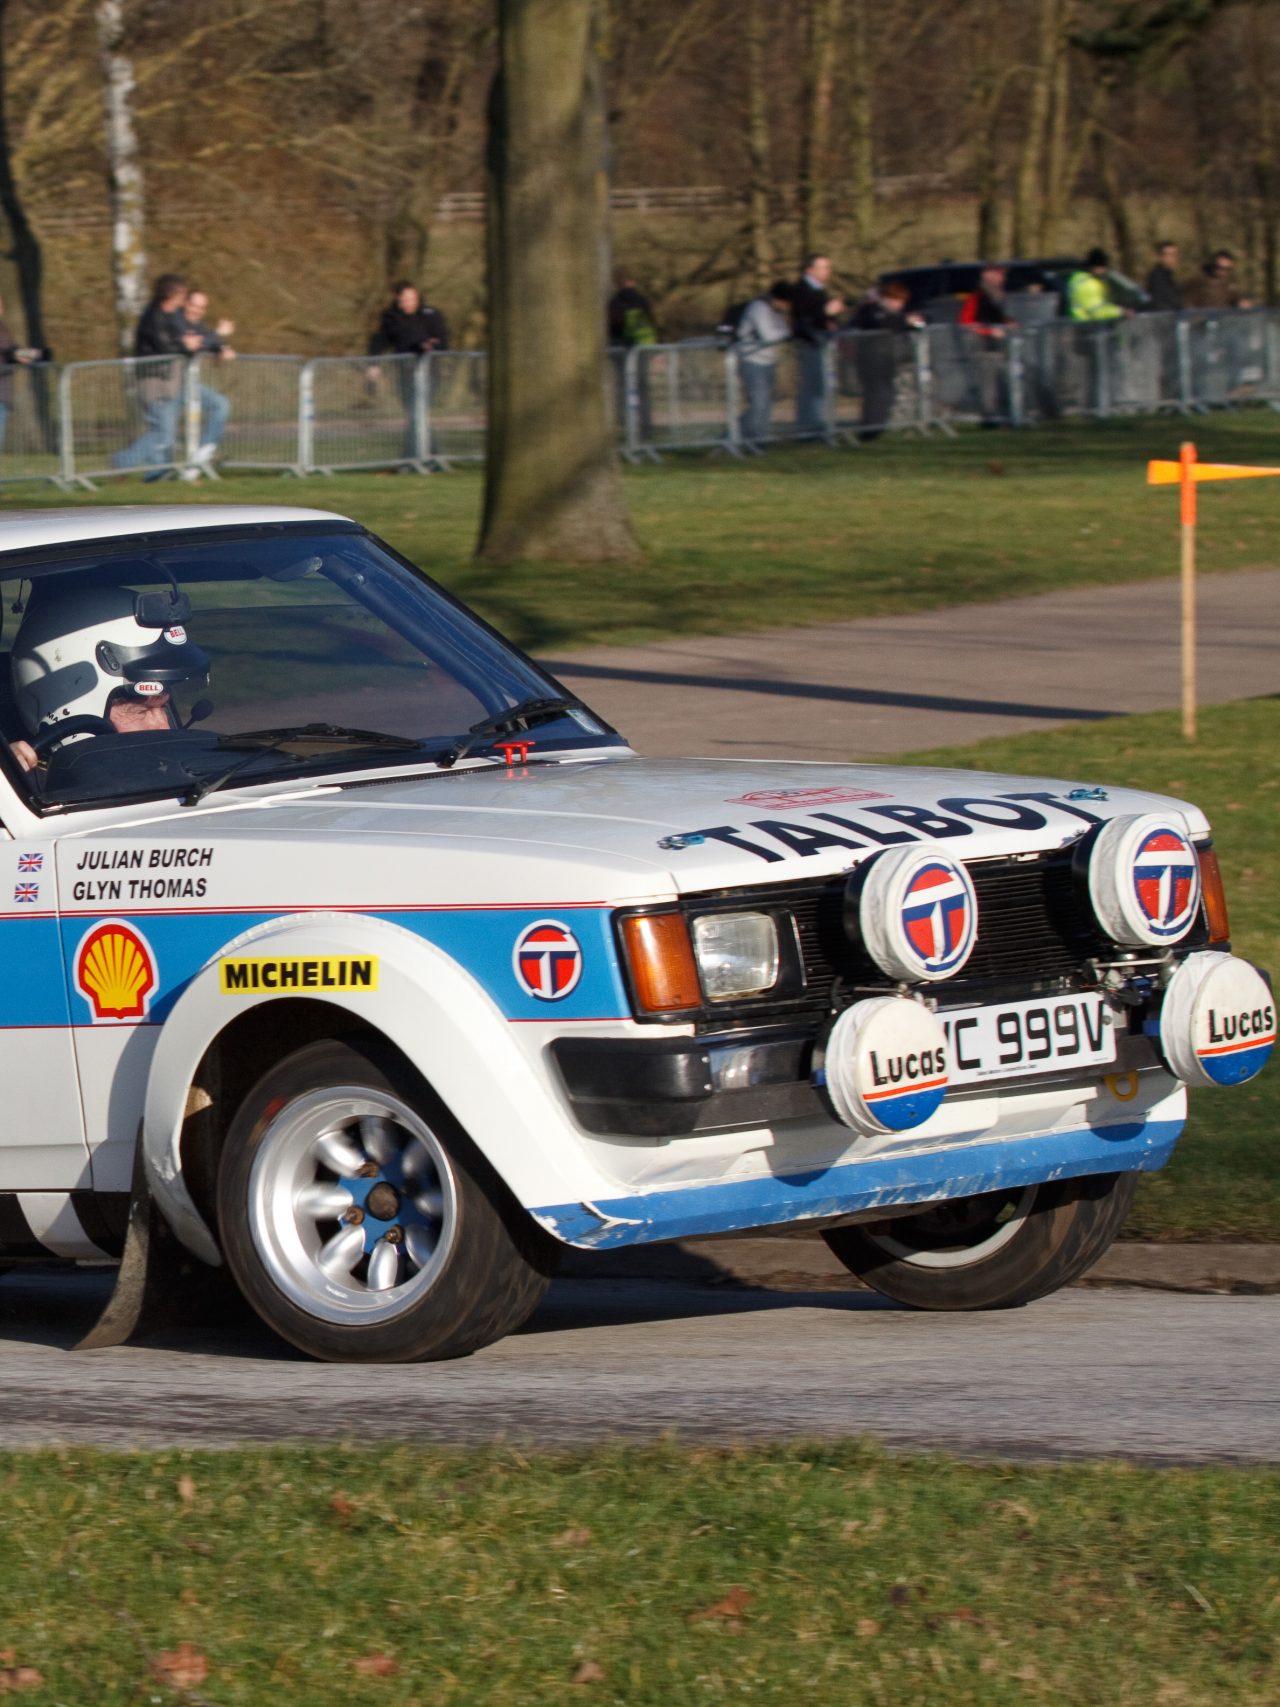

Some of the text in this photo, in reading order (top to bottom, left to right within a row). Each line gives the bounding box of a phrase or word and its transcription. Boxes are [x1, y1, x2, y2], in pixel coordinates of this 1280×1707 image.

[139, 684, 159, 692] BELL
[674, 792, 1103, 863] TALBOT
[77, 848, 214, 870] JULIAN BURCH
[73, 878, 207, 901] GLYN THOMAS
[225, 960, 372, 988] MICHELIN
[997, 1000, 1103, 1064] 999V
[1208, 1005, 1273, 1043] Lucas
[870, 1047, 945, 1086] Lucas
